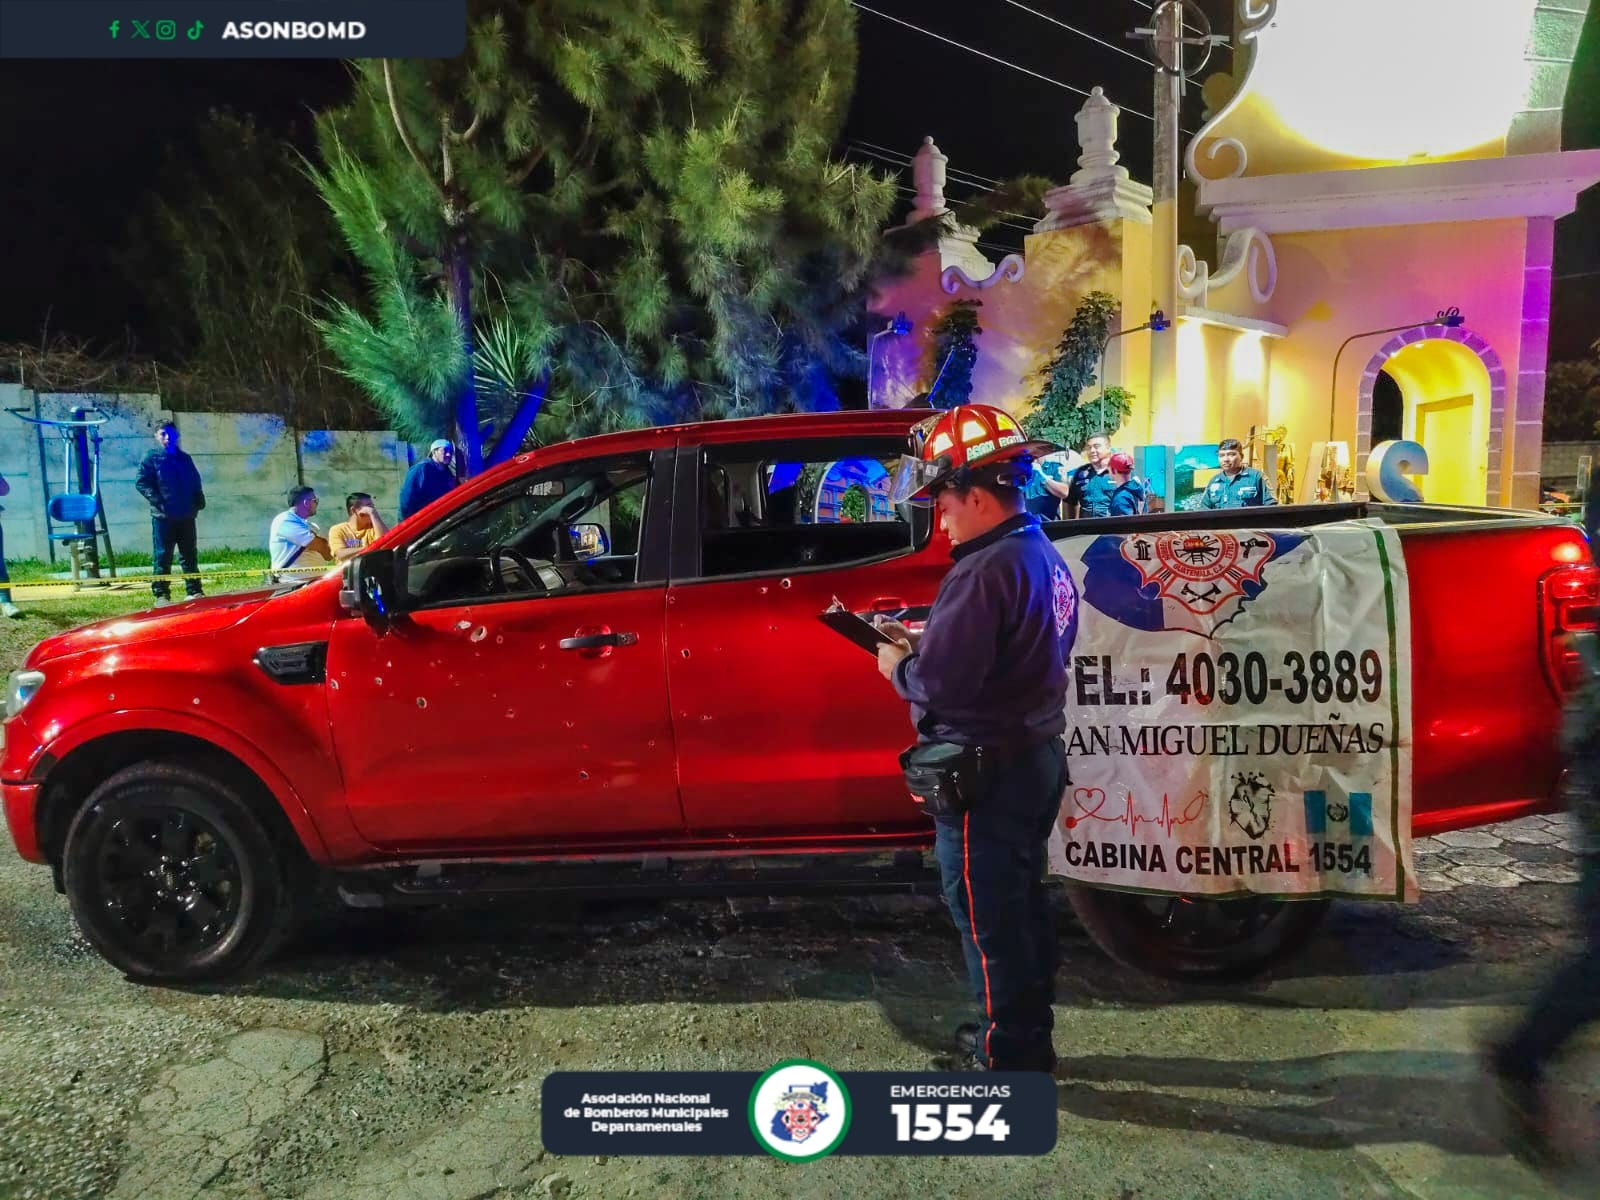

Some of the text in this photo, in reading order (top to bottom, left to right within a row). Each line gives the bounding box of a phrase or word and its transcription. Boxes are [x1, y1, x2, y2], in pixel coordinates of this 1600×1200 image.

[1065, 649, 1383, 706] EL.: 4030-3889
[1066, 712, 1385, 757] AN MIGUEL DUEÑAS
[1065, 840, 1373, 876] CABINA CENTRAL 1554
